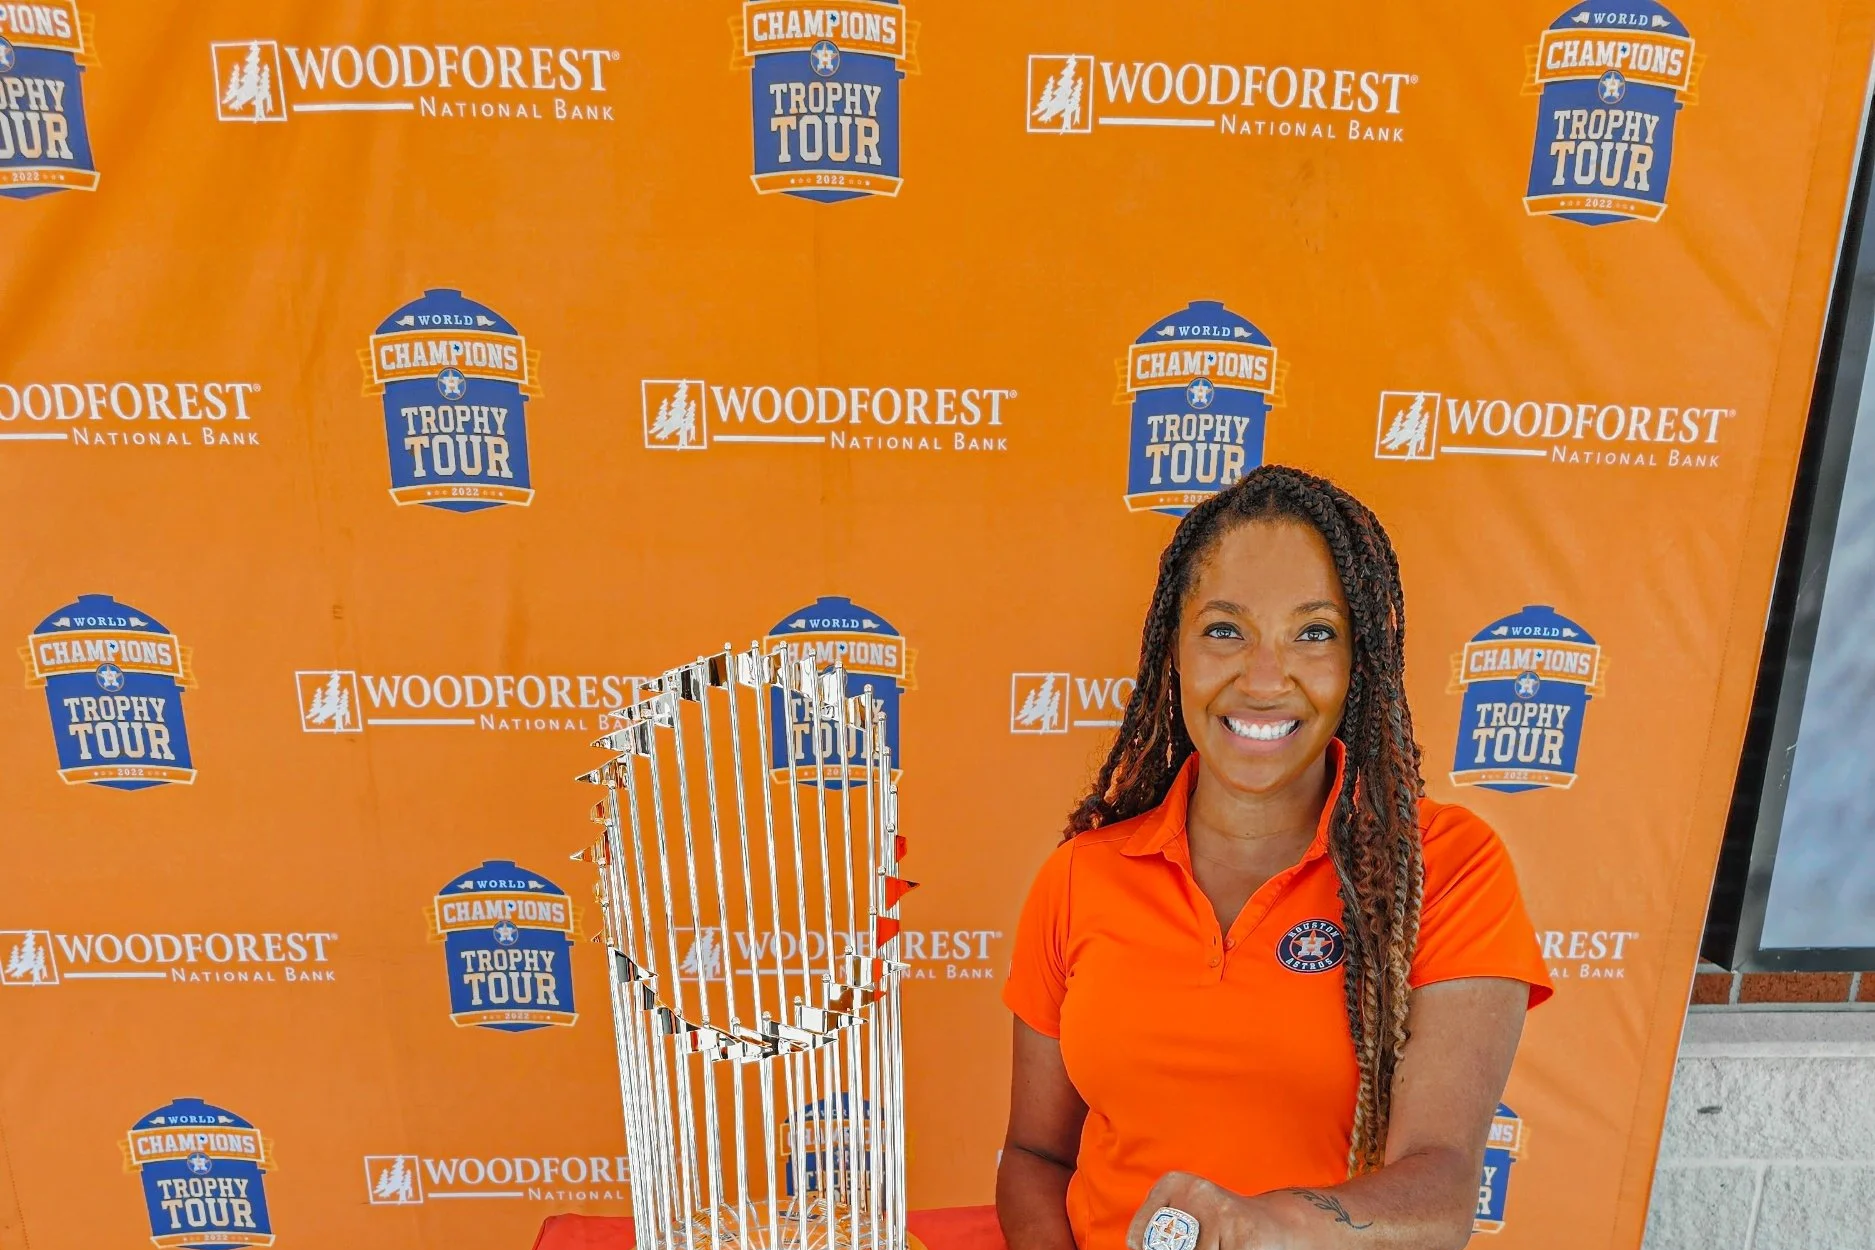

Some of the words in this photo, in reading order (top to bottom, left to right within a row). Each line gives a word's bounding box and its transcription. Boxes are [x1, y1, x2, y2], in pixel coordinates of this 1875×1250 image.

[753, 10, 897, 44] CHAMPIONS
[1594, 12, 1649, 26] WORLD
[1546, 39, 1685, 77] CHAMPIONS
[419, 96, 543, 119] NATIONAL
[555, 98, 615, 122] BANK
[769, 82, 882, 117] TROPHY
[0, 111, 74, 160] OUR
[1220, 114, 1336, 139] NATIONAL
[1348, 119, 1404, 142] BANK
[1554, 109, 1660, 145] TROPHY
[770, 115, 882, 166] TOUR
[12, 172, 40, 182] 2022
[1550, 141, 1654, 192] TOUR
[815, 175, 845, 185] 2022
[1584, 198, 1613, 209] 2022
[418, 314, 474, 326] WORLD
[1178, 326, 1231, 337] WORLD
[380, 340, 518, 371] CHAMPIONS
[1136, 350, 1268, 381] CHAMPIONS
[401, 405, 508, 436] TROPHY
[1147, 413, 1250, 445] TROPHY
[72, 426, 192, 446] NATIONAL
[202, 427, 260, 445] BANK
[830, 431, 943, 450] NATIONAL
[954, 432, 1008, 451] BANK
[404, 434, 514, 479] TOUR
[1145, 442, 1246, 486] TOUR
[1552, 445, 1658, 467] NATIONAL
[1669, 449, 1721, 468] BANK
[451, 487, 480, 497] 2022
[72, 616, 127, 627] WORLD
[809, 618, 860, 629] WORLD
[1511, 626, 1560, 638] WORLD
[39, 639, 173, 666] CHAMPIONS
[1469, 647, 1592, 676] CHAMPIONS
[63, 695, 166, 724] TROPHY
[1476, 702, 1571, 730] TROPHY
[480, 714, 588, 731] NATIONAL
[68, 721, 176, 761] TOUR
[1472, 726, 1565, 766] TOUR
[117, 768, 144, 777] 2022
[476, 879, 526, 889] WORLD
[443, 900, 565, 924] CHAMPIONS
[1288, 922, 1339, 938] HOUSTON
[460, 949, 555, 973] TROPHY
[946, 963, 994, 979] BANK
[1286, 957, 1333, 970] ASTROS
[1580, 963, 1625, 979] BANK
[171, 966, 275, 982] NATIONAL
[285, 966, 336, 981] BANK
[463, 971, 559, 1006] TOUR
[168, 1115, 216, 1125] WORLD
[137, 1133, 256, 1156] CHAMPIONS
[423, 1157, 631, 1185] WOODFORE
[157, 1177, 249, 1200] TROPHY
[528, 1186, 625, 1201] NATIONAL
[161, 1197, 256, 1229] TOUR
